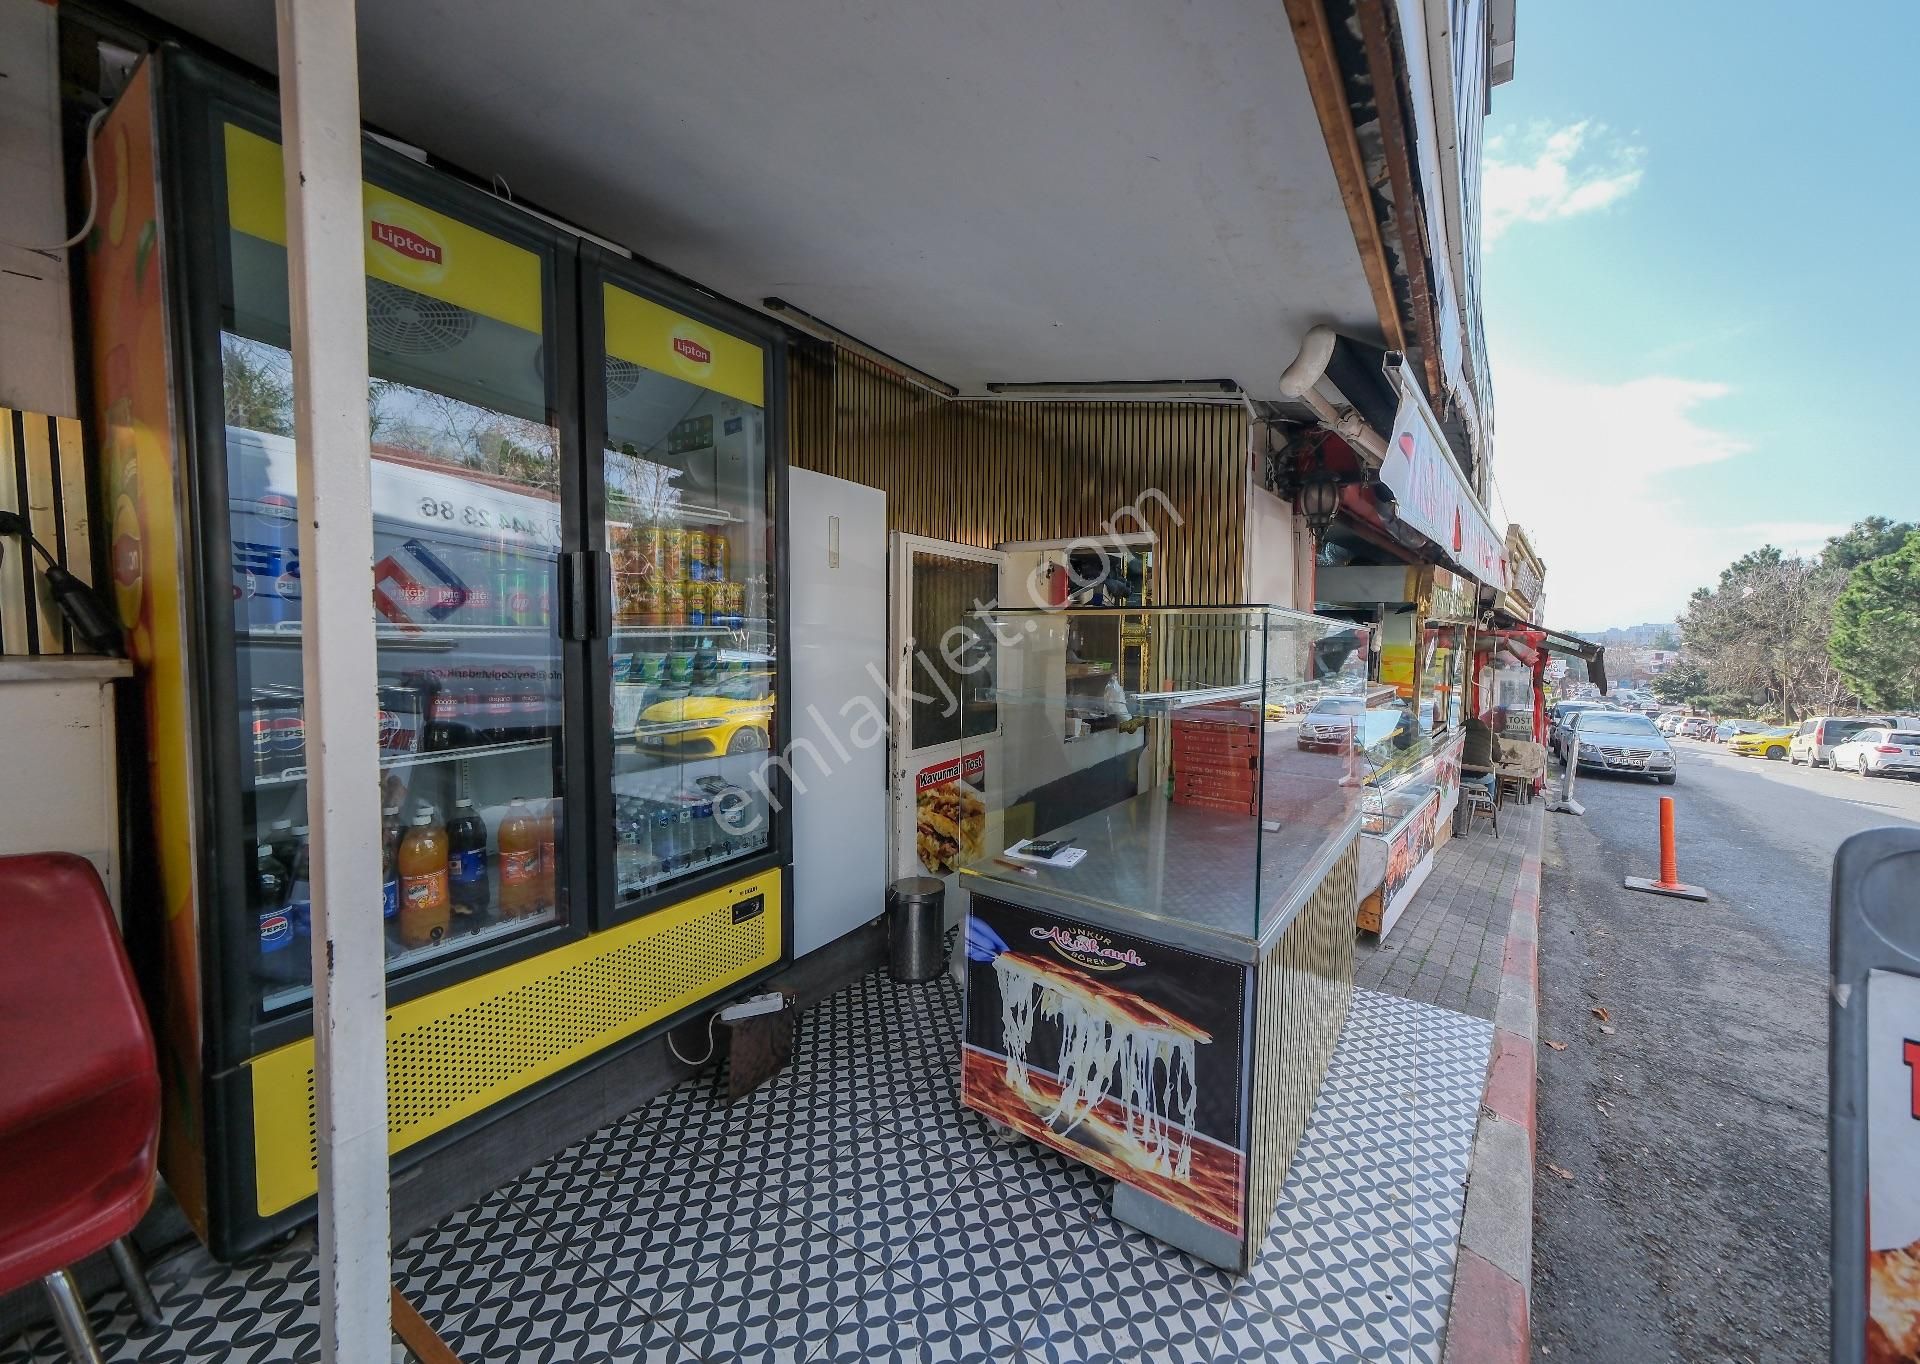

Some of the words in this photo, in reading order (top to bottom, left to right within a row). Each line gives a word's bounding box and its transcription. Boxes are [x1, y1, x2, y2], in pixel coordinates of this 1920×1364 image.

[378, 225, 436, 259] Lipton
[677, 340, 708, 360] Lipton
[1508, 716, 1531, 724] TOST
[965, 755, 983, 772] Tost
[261, 922, 287, 934] PEPSI
[1071, 951, 1108, 966] BÖREK
